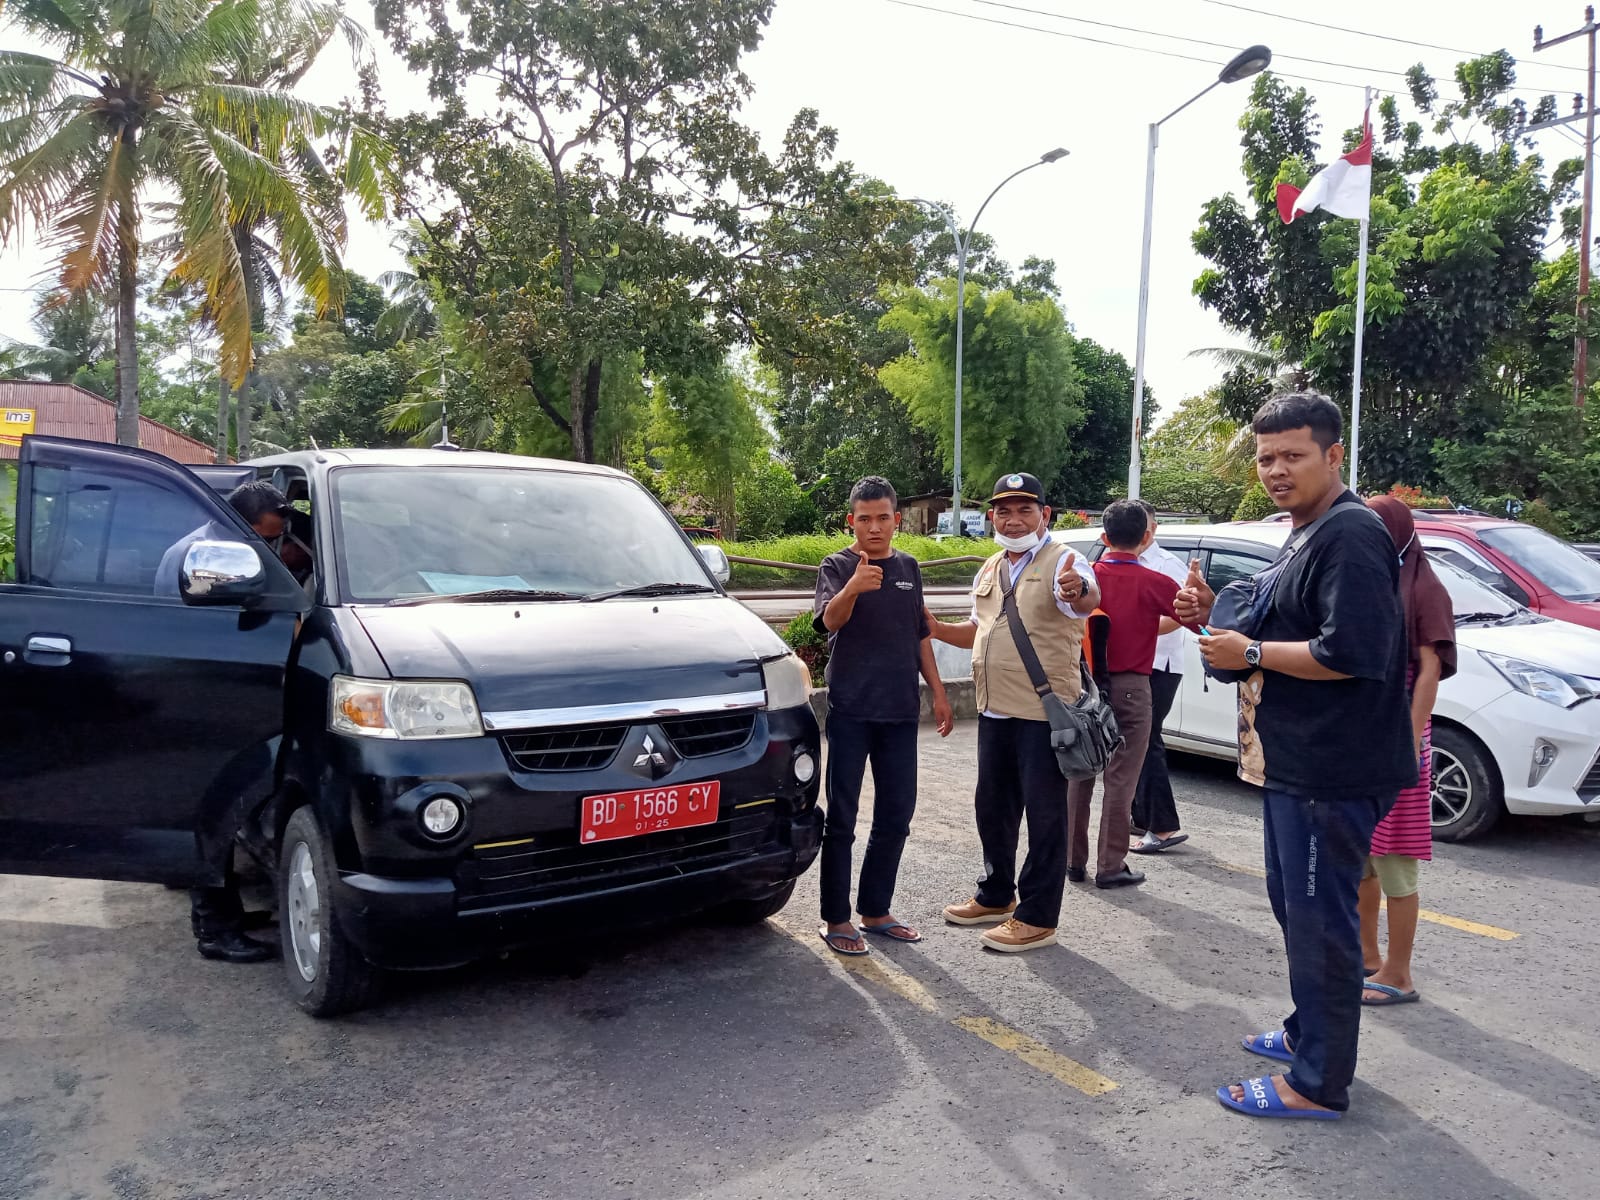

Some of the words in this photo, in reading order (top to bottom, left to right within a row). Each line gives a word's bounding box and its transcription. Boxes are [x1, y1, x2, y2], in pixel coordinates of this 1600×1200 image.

[592, 797, 617, 826] BD
[633, 790, 678, 819] 1566
[688, 785, 712, 812] CY
[635, 819, 669, 831] 01-25
